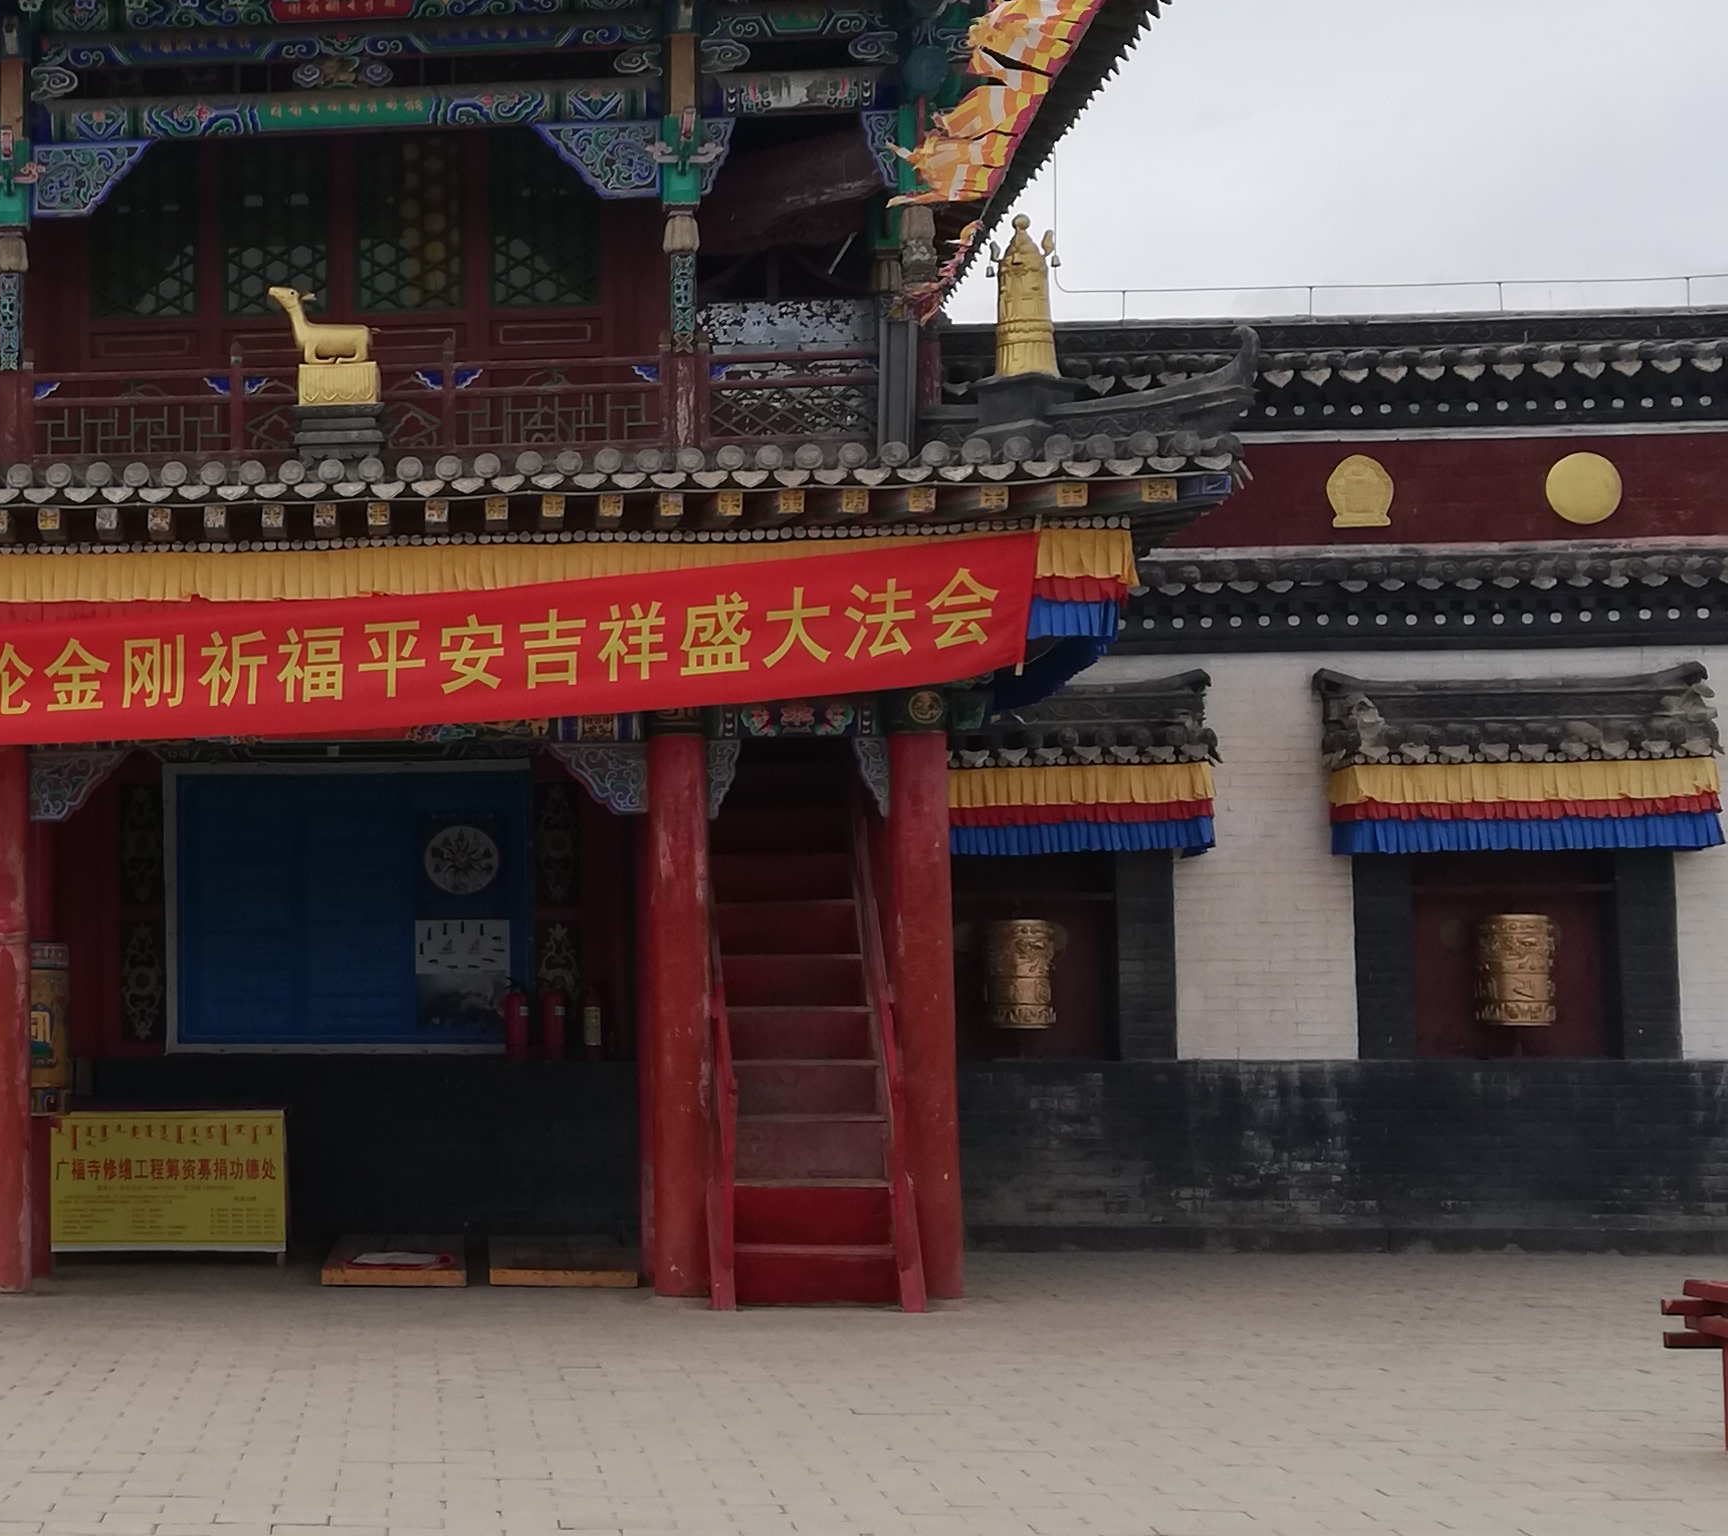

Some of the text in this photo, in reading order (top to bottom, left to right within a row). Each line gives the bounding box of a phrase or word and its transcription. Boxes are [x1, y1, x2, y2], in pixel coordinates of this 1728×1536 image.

[55, 1158, 277, 1181] 广福寺修缮工程筹资募捐功德处
